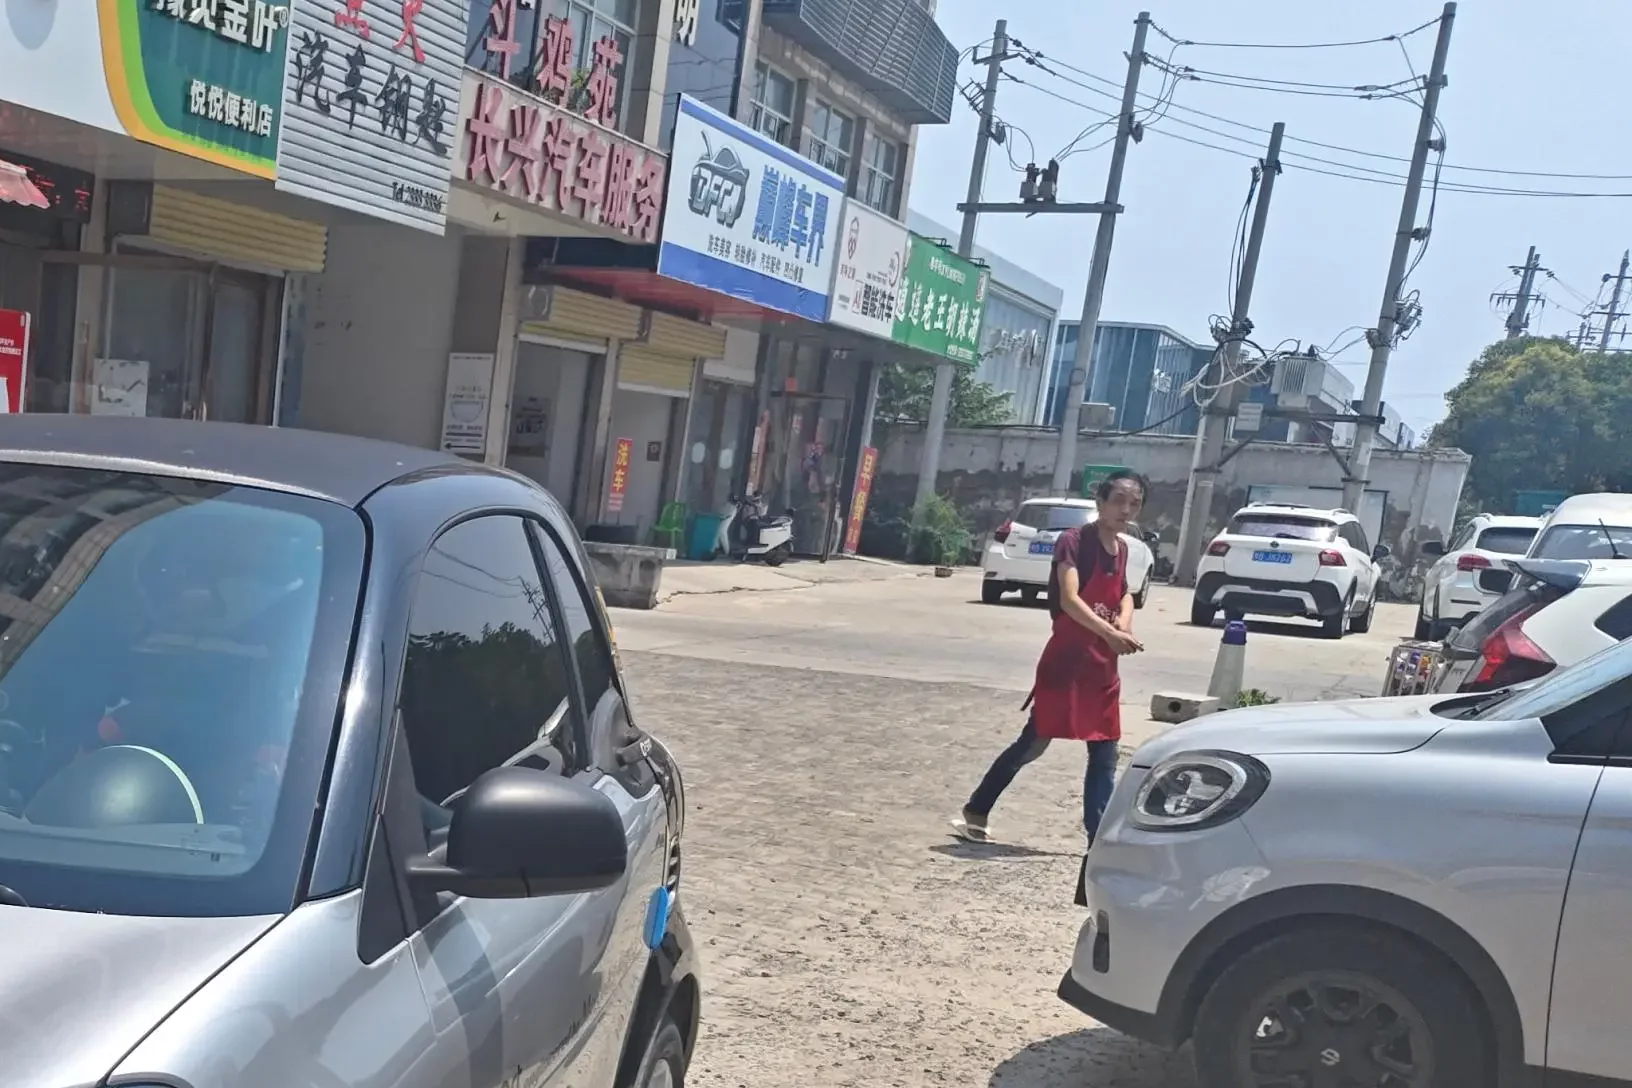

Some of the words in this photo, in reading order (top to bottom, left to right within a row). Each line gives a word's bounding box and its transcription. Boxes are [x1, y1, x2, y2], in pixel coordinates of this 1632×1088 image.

[189, 78, 274, 138] 悦悦便利店
[295, 29, 448, 157] 汽车钥匙
[466, 83, 665, 241] 长兴汽车服务
